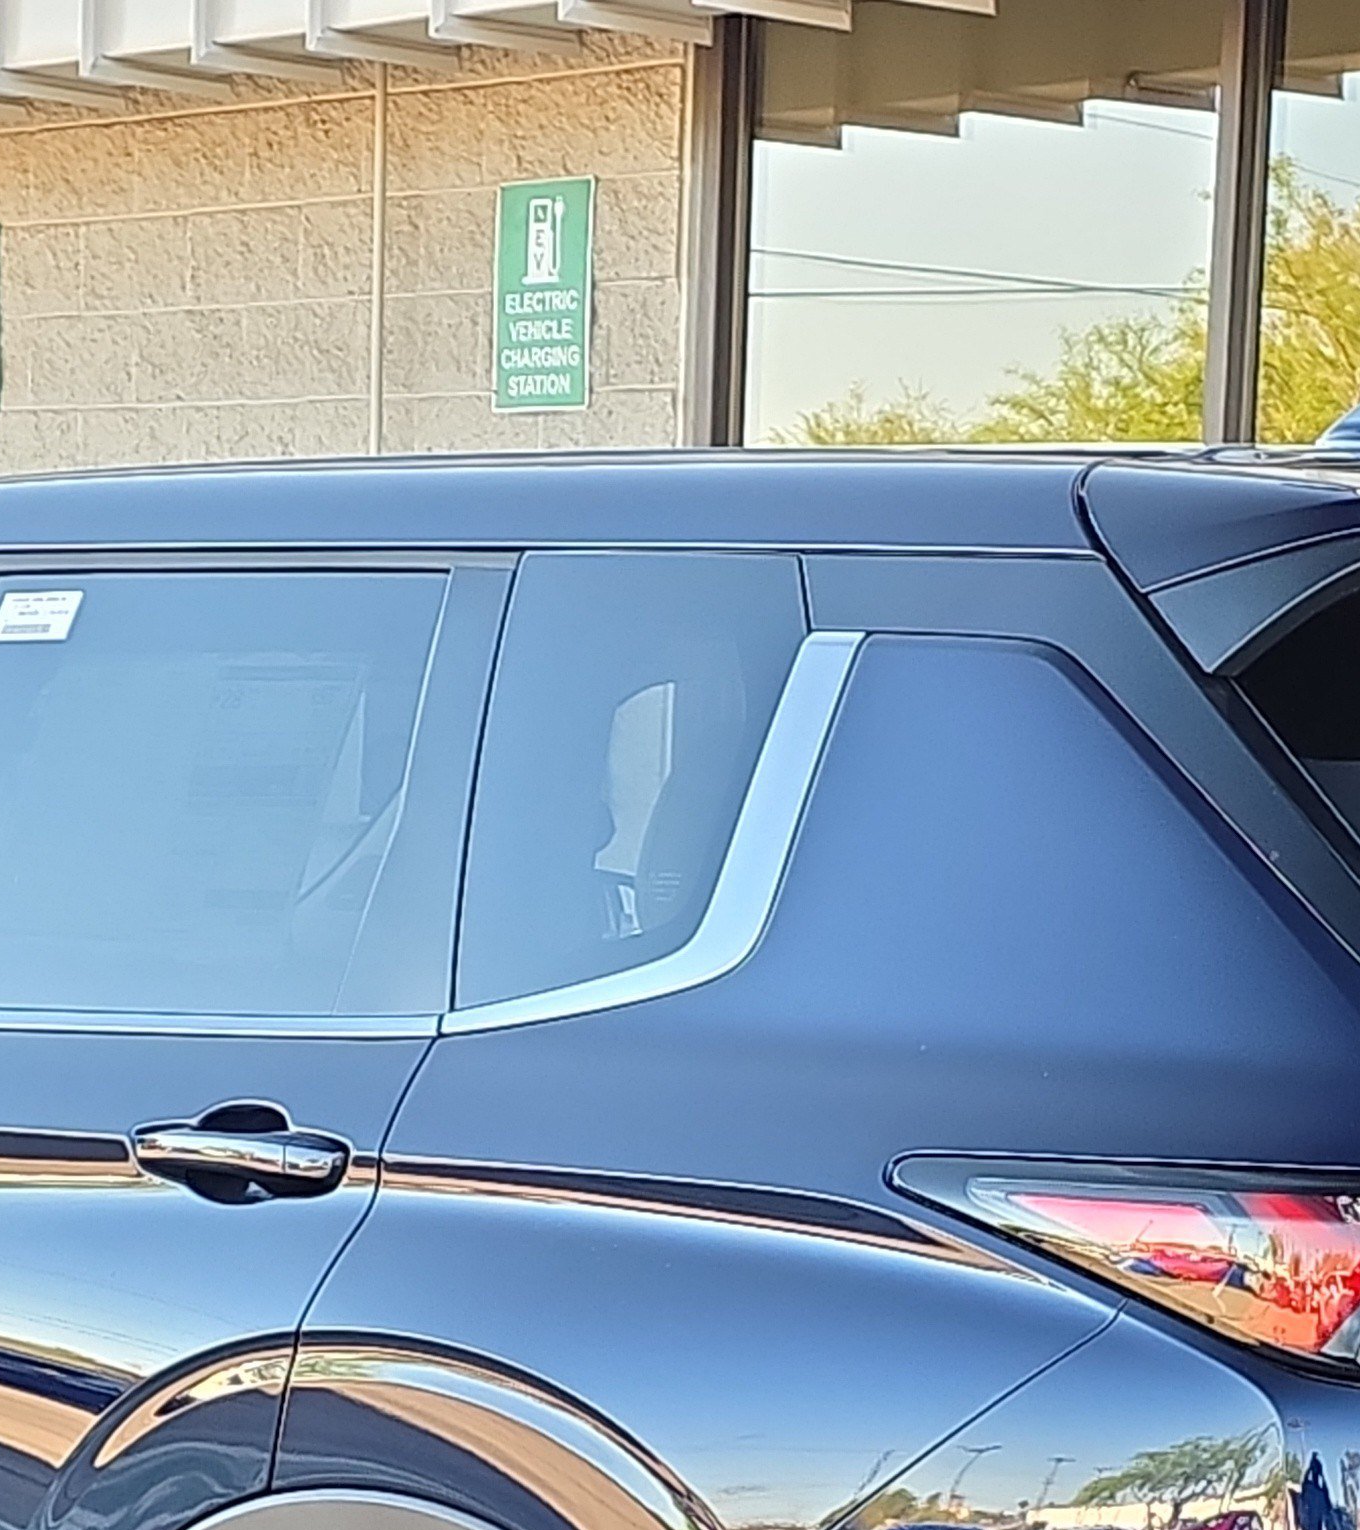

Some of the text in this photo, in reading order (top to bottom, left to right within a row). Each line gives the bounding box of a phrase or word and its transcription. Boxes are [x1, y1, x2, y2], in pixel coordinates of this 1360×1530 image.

[505, 289, 579, 315] ELECTRIC
[508, 318, 574, 342] VEHICLE
[500, 345, 580, 370] CHARGING
[507, 373, 572, 397] STATION
